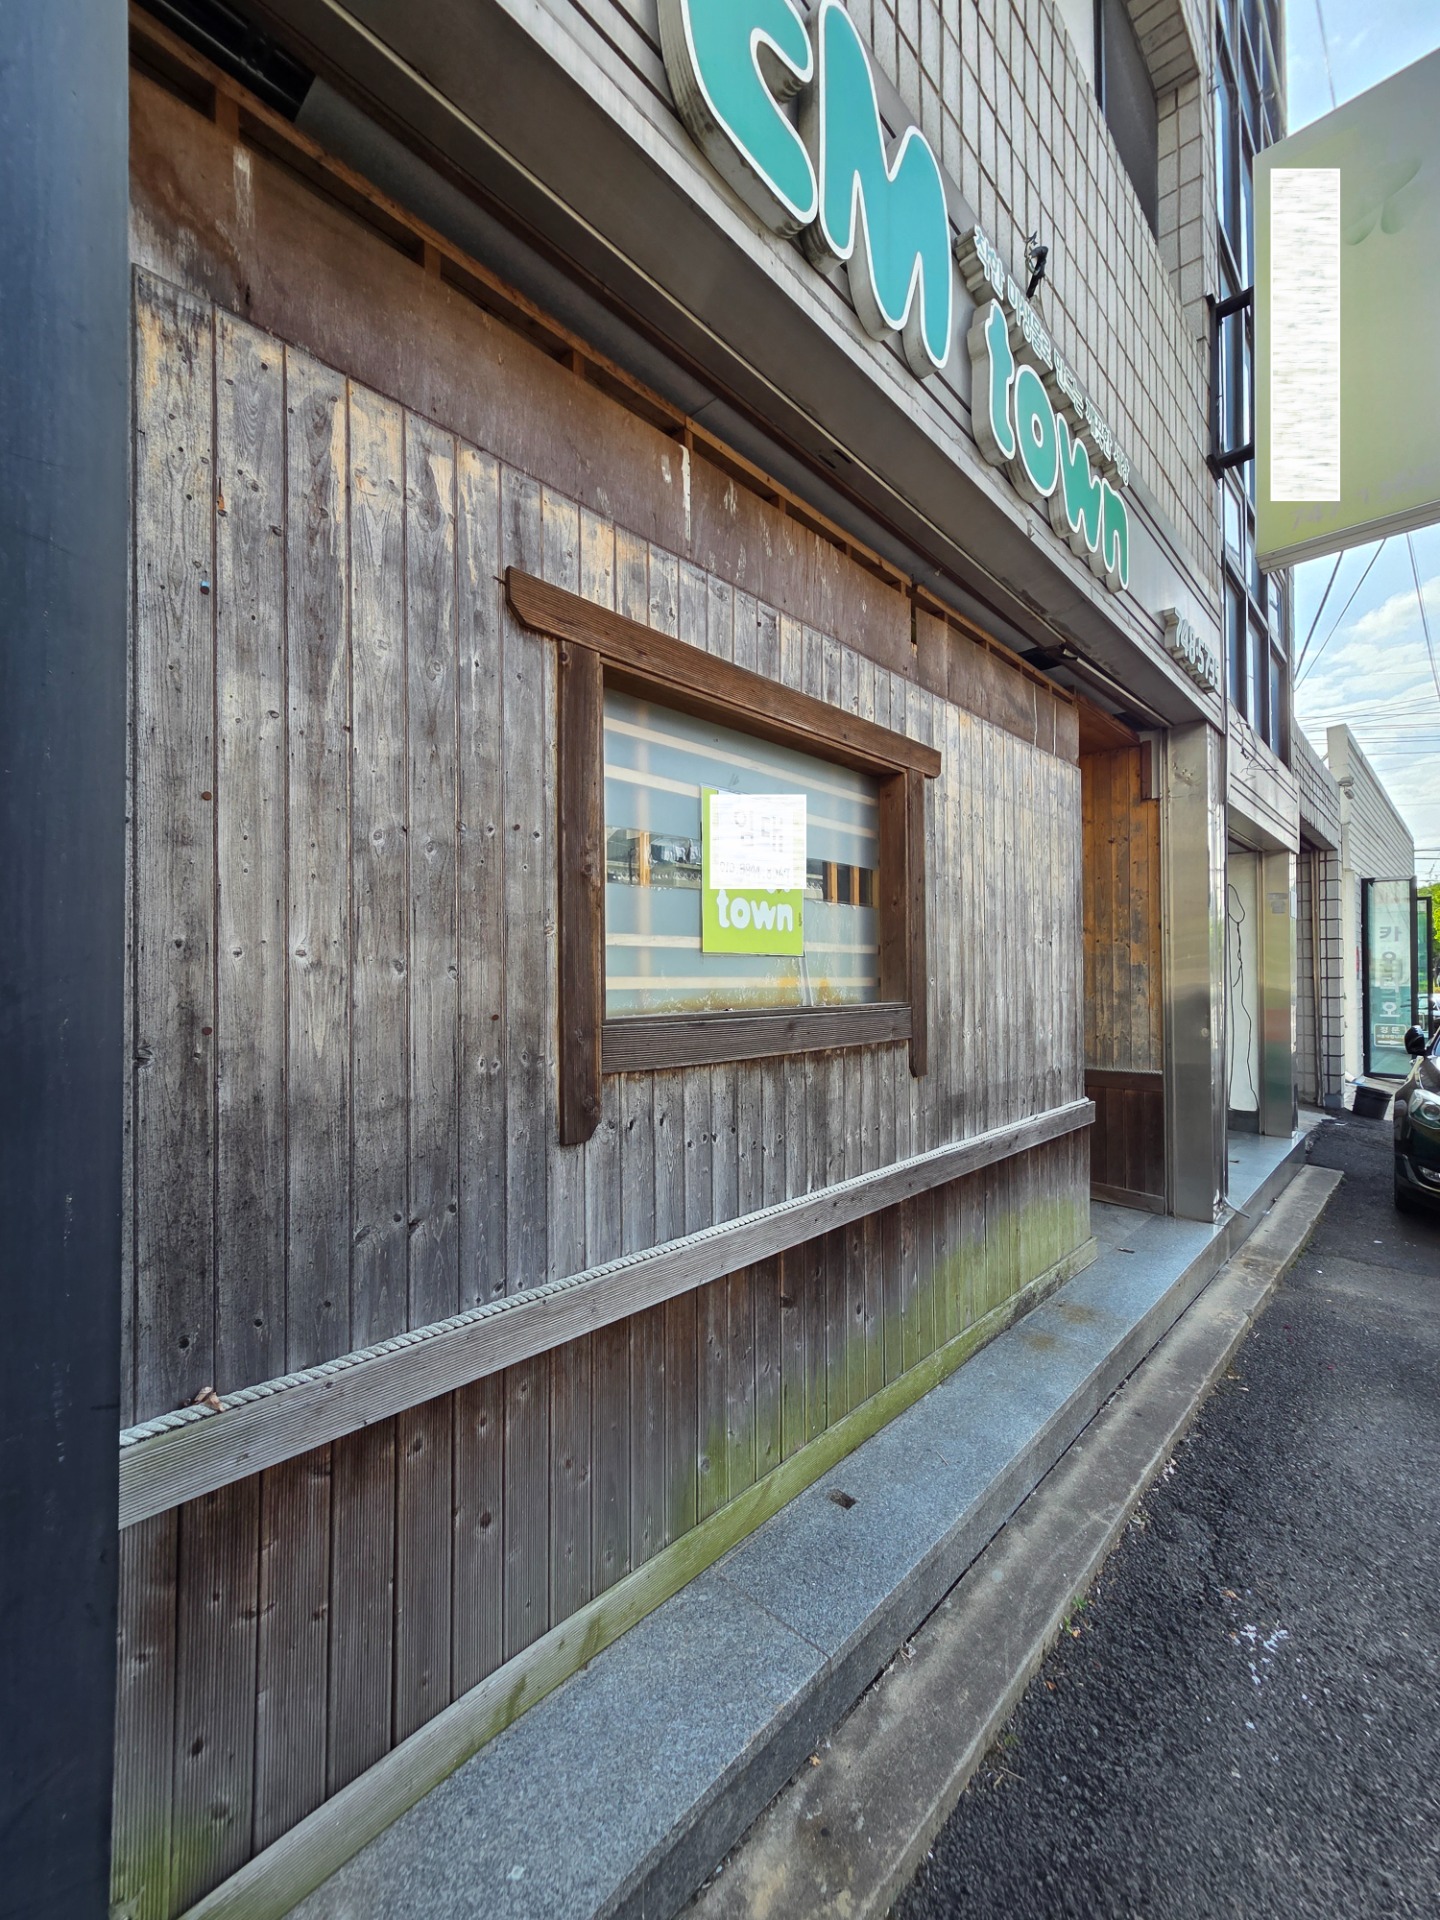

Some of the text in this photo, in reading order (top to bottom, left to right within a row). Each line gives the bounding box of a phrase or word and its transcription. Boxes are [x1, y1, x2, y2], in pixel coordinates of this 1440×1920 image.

[973, 224, 1005, 301] 착한
[1007, 274, 1053, 371] 미생물로
[1054, 348, 1084, 419] 만드는
[985, 298, 1129, 590] town
[716, 889, 793, 932] town
